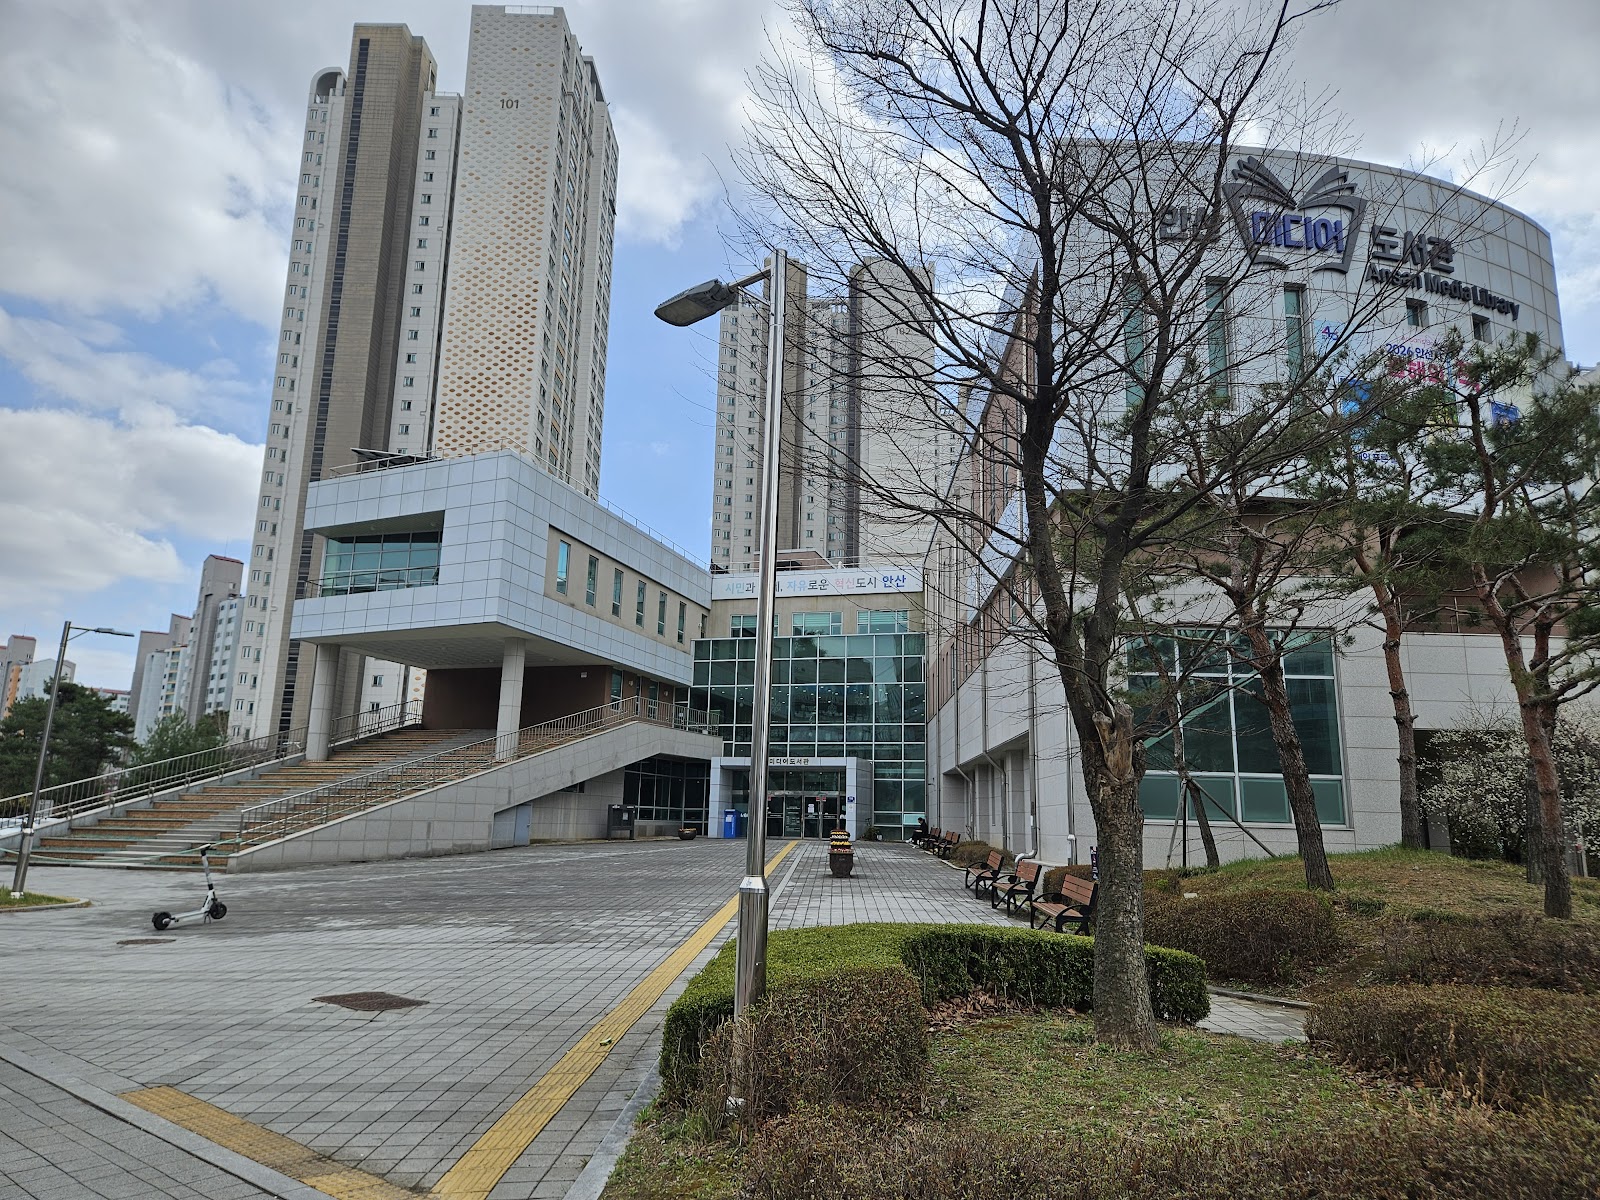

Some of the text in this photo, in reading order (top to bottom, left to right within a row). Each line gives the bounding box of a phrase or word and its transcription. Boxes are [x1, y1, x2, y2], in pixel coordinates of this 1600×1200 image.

[500, 98, 519, 109] 101
[1252, 211, 1345, 253] 미디어
[1371, 224, 1456, 274] 도서관
[1365, 262, 1520, 322] Ansan Media Library
[725, 581, 756, 595] 시민과
[786, 578, 829, 592] 자유로운
[834, 576, 878, 590] 혁신도시
[882, 574, 907, 589] 안산
